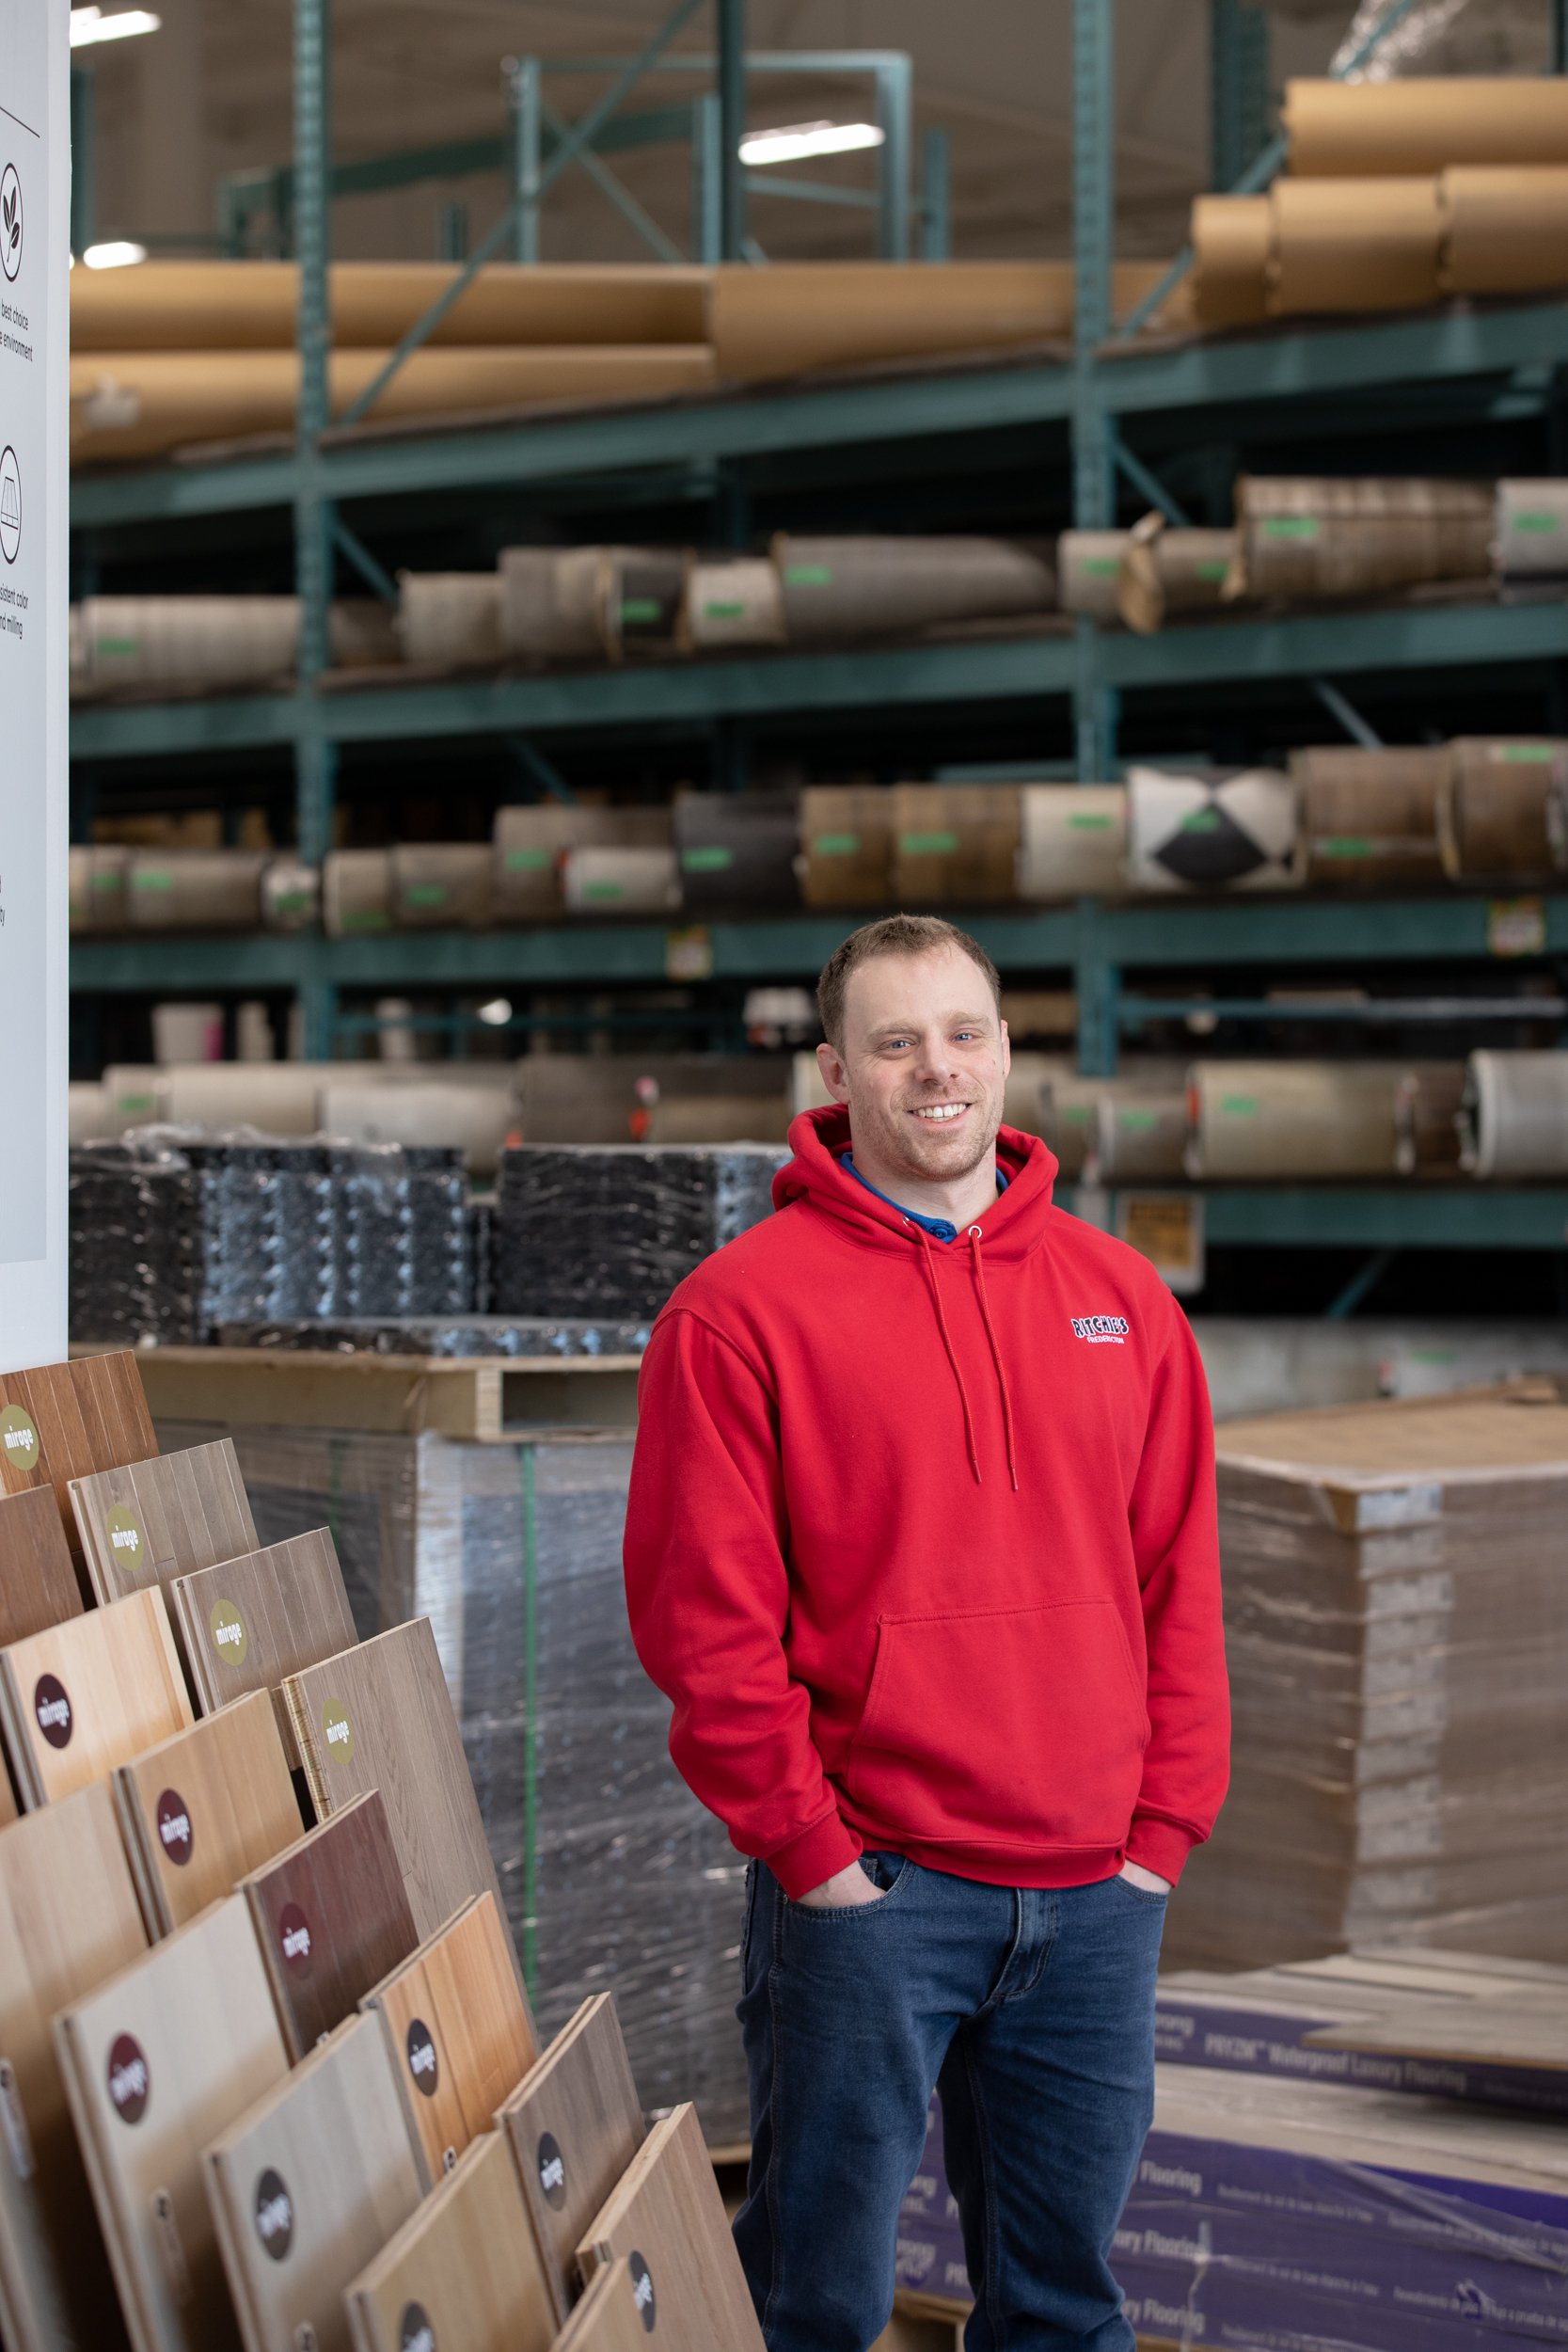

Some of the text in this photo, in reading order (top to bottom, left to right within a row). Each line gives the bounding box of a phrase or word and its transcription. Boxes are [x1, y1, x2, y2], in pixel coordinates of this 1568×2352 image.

[2, 298, 29, 331] best choice
[4, 333, 33, 362] environment
[17, 590, 28, 610] color
[4, 1424, 34, 1452] mirage
[111, 1524, 139, 1551] mirage
[215, 1620, 242, 1645] mirage
[38, 1696, 70, 1728] mirage
[325, 1719, 349, 1744] mirage
[161, 1813, 190, 1844] mirage
[282, 1926, 310, 1958] mirage
